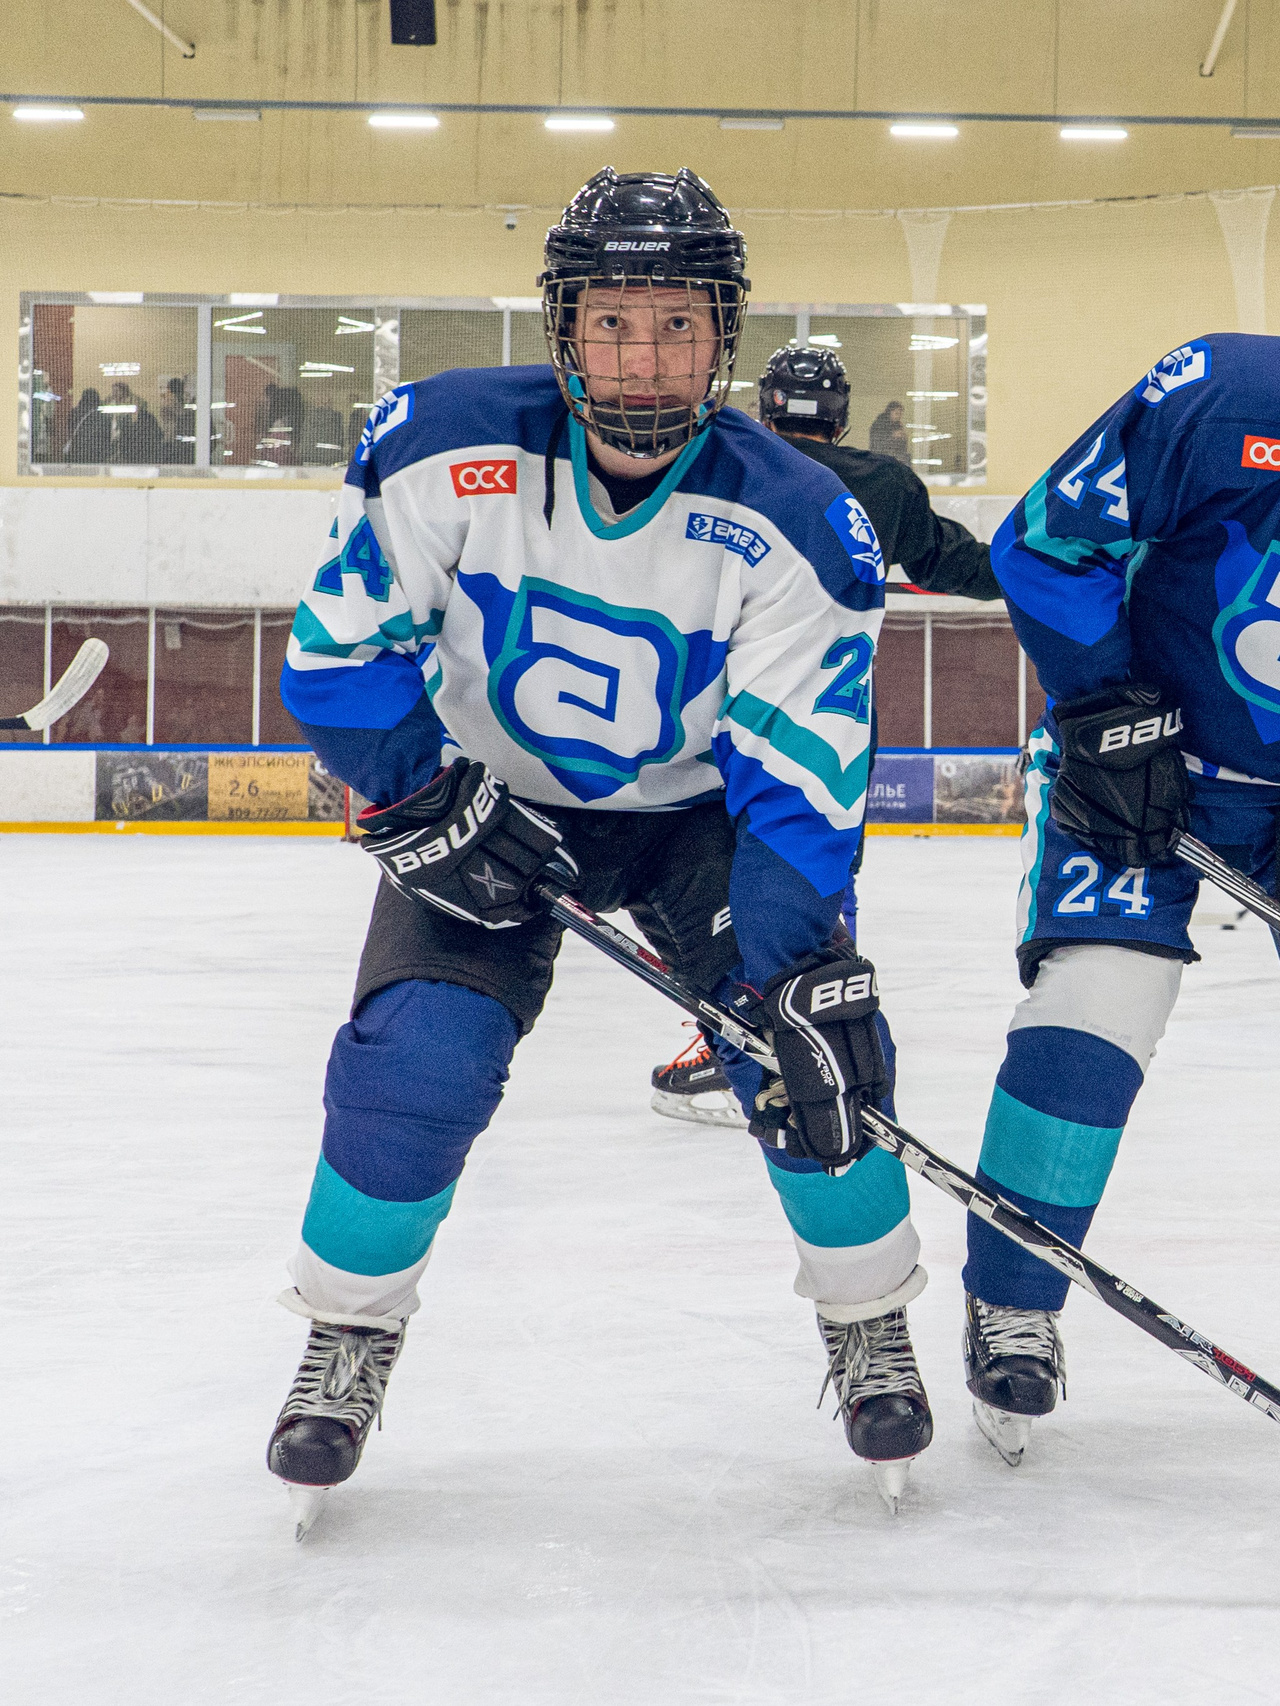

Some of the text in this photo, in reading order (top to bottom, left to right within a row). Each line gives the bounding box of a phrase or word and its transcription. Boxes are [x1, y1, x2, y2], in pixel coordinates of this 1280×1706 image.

[604, 241, 671, 251] BAUER
[811, 631, 870, 724] 2
[1099, 707, 1184, 753] BAU
[868, 783, 906, 799] ЛЬЕ
[391, 767, 504, 874] BAUER
[1053, 851, 1154, 920] 24
